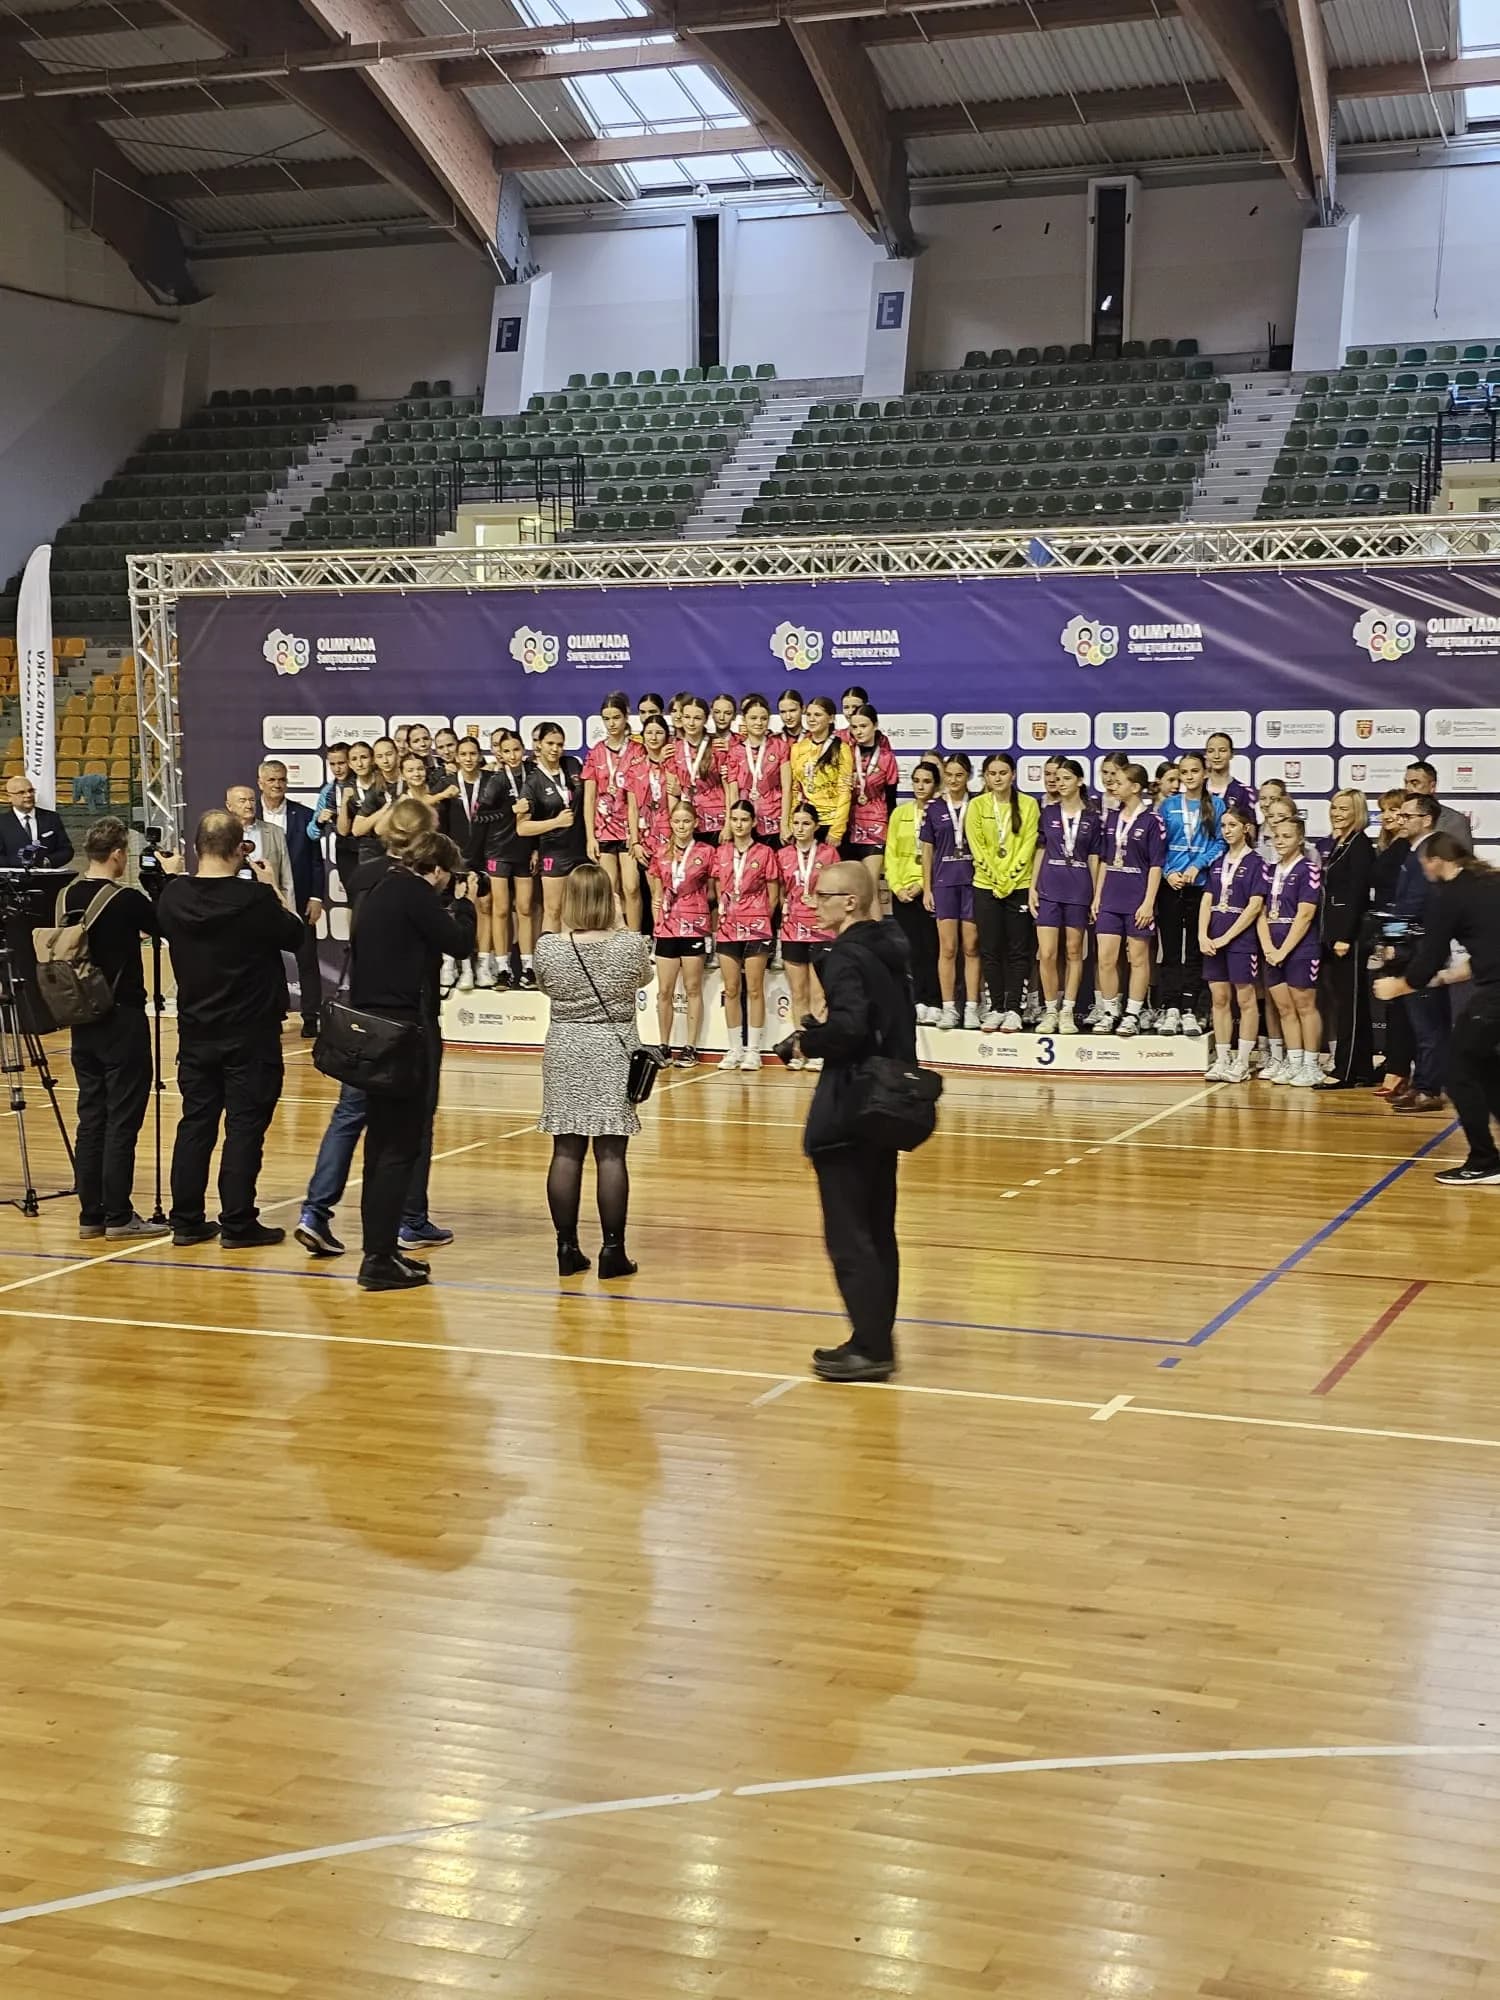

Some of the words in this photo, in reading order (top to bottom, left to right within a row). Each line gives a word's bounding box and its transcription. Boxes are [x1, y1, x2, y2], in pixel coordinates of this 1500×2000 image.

[881, 295, 897, 325] E
[501, 320, 514, 348] F
[832, 630, 900, 645] OLIMPIADA
[1128, 623, 1203, 639] OLIMPIADA
[317, 637, 377, 652] OLIMPIADA
[567, 634, 630, 649] OLIMPIADA
[1050, 727, 1078, 736] Kielce
[1376, 725, 1406, 734] Kielce
[615, 771, 625, 788] 6
[1036, 1037, 1056, 1066] 3
